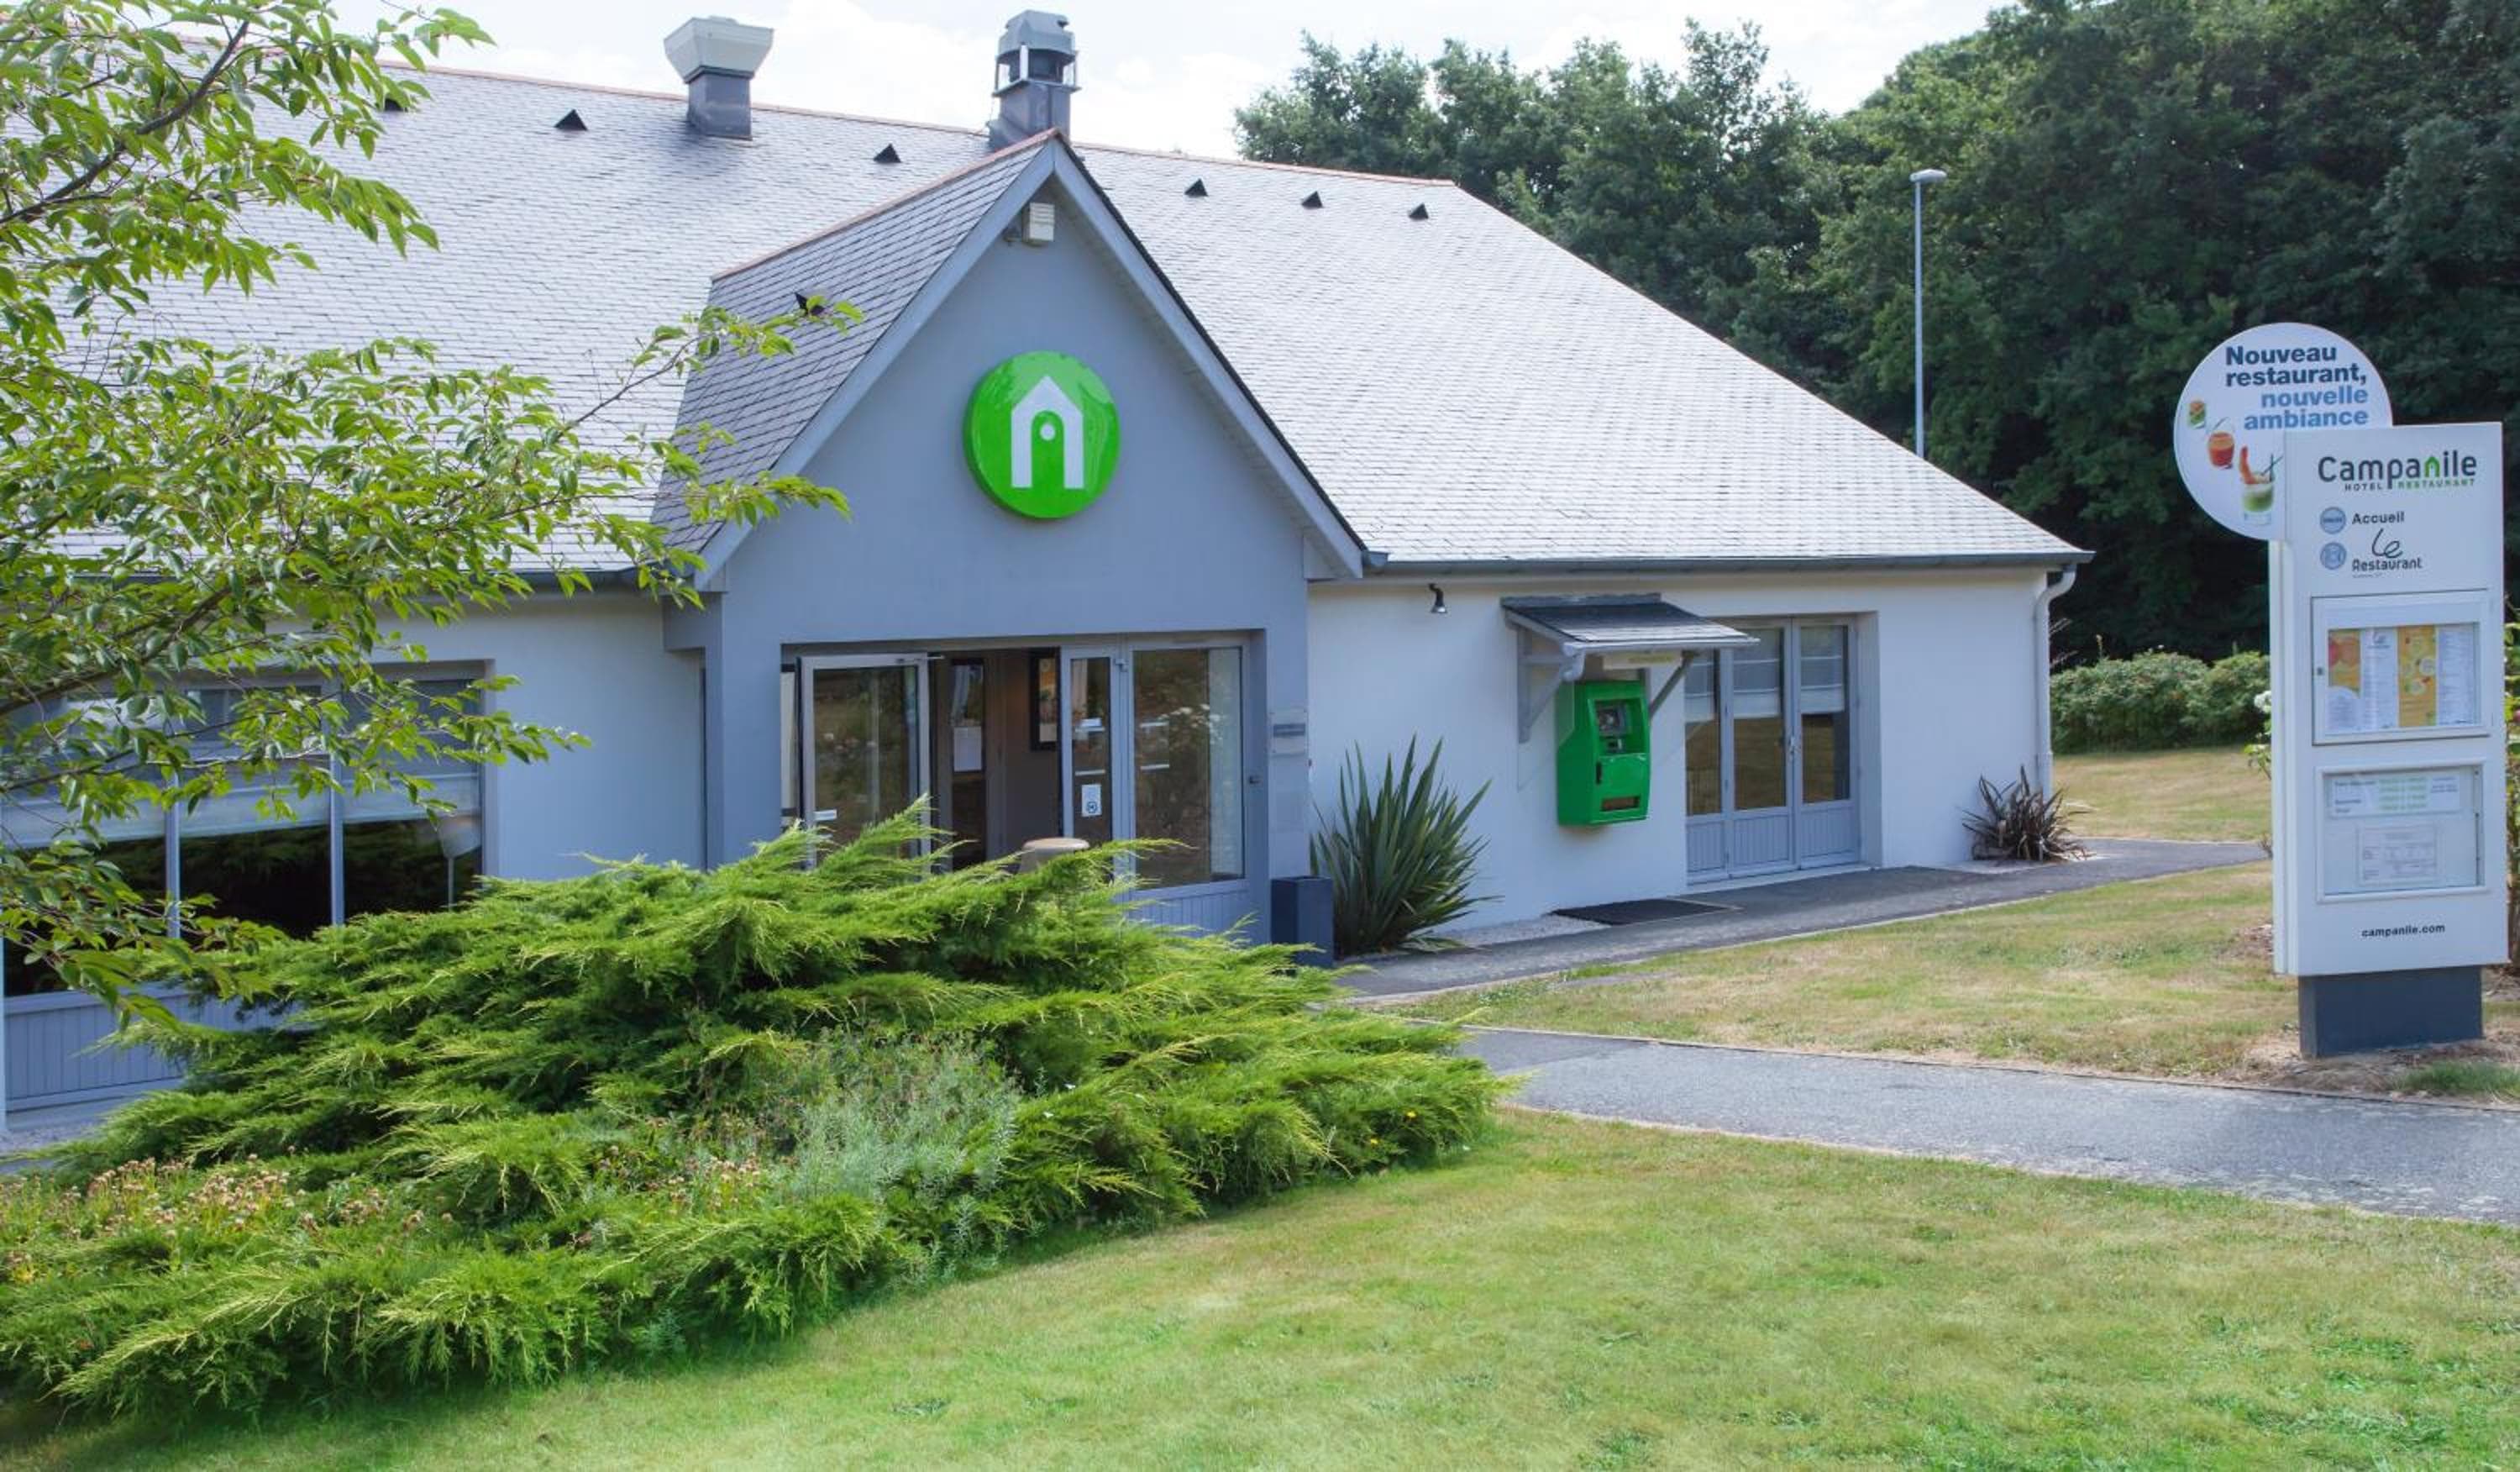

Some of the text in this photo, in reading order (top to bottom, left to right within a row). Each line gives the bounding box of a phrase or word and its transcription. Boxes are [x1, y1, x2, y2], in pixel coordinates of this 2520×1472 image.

[2226, 345, 2337, 365] Nouveau
[2226, 363, 2366, 386] restaurant,
[2261, 385, 2368, 408] nouvelle
[2244, 408, 2369, 430] ambiance
[2318, 449, 2477, 490] Campanile
[2344, 478, 2475, 492] HOTEL RESTAURANT
[2351, 511, 2405, 524] Accueil
[2351, 557, 2423, 571] Restaurant
[2360, 923, 2446, 938] campanile.com
